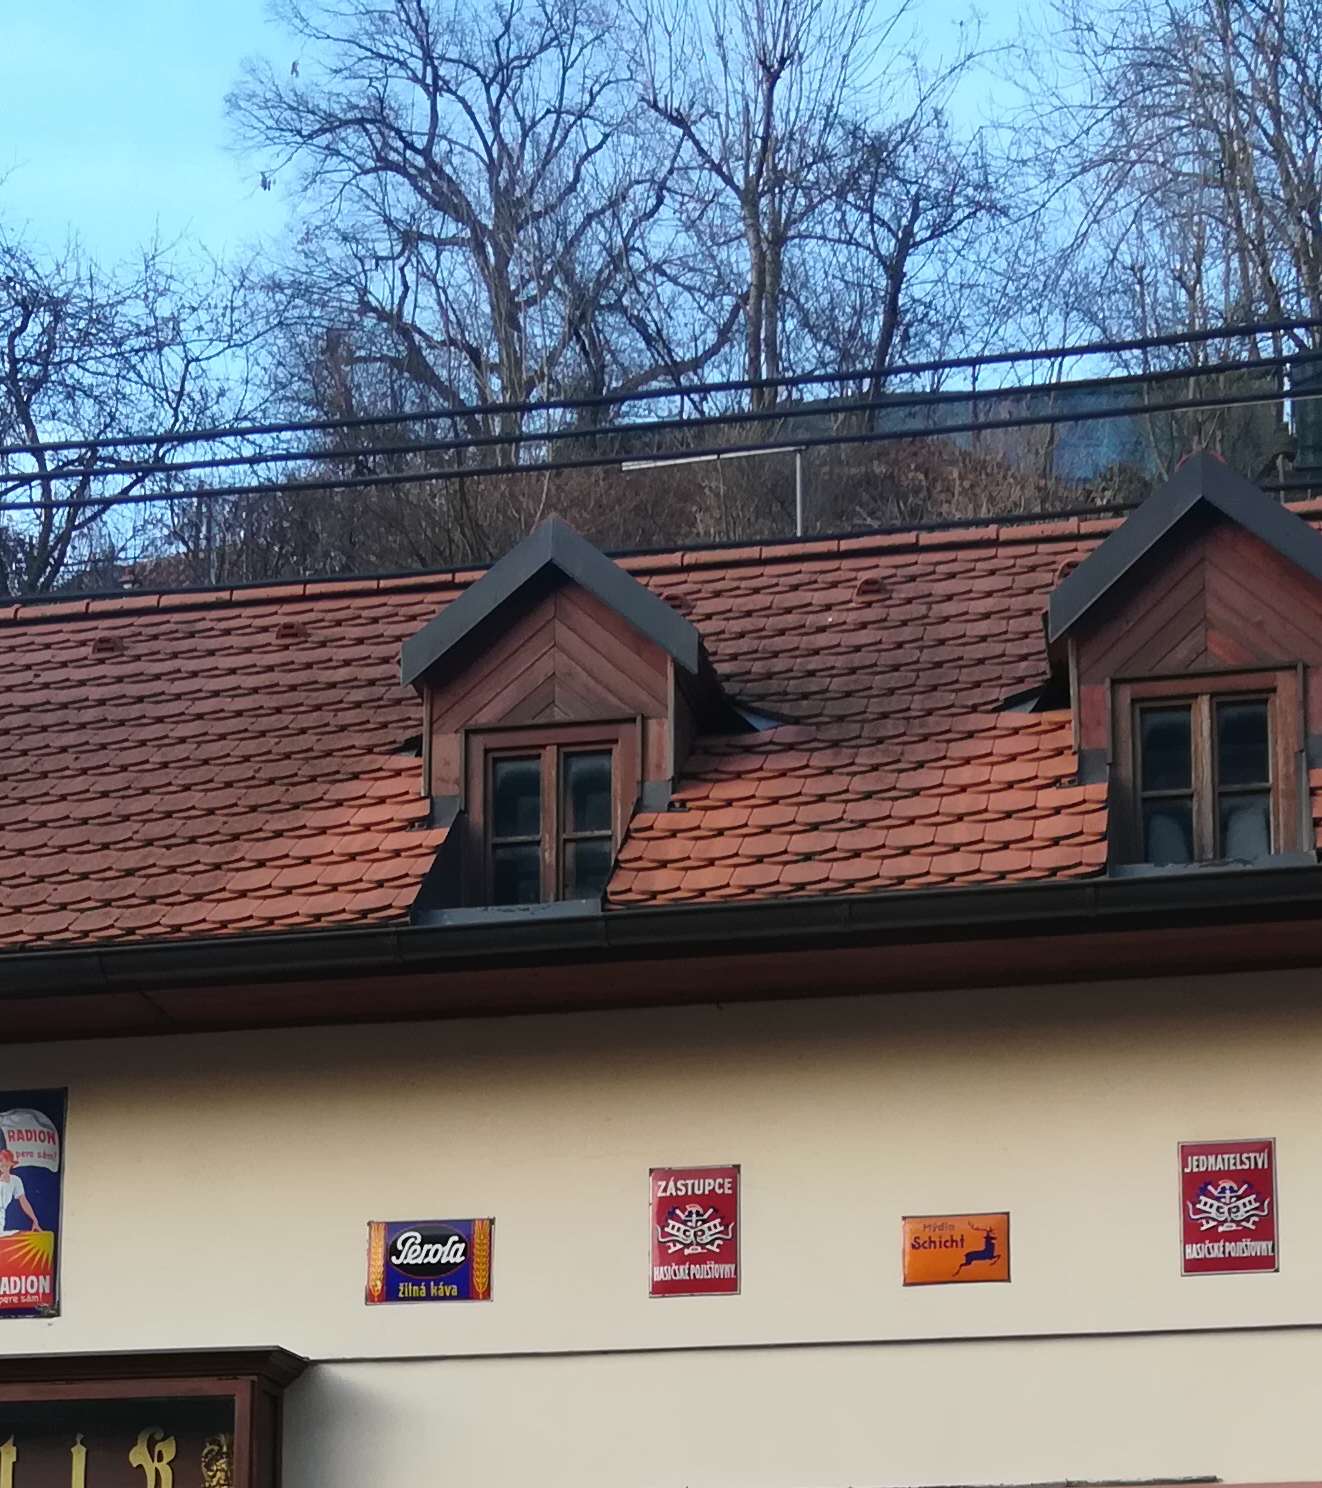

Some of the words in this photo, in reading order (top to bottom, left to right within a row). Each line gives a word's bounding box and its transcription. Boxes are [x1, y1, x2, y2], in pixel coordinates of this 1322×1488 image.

[7, 1128, 56, 1146] RADION
[1183, 1148, 1269, 1173] JEDNATELSTVÍ
[656, 1176, 733, 1198] ZÁSTUPCE
[922, 1221, 956, 1233] Mýdlo
[390, 1230, 466, 1265] Perola
[910, 1233, 965, 1250] Schicht
[1185, 1238, 1225, 1260] HASIČSKÉ
[653, 1261, 690, 1282] HASIČSKÉ
[430, 1280, 458, 1297] káva
